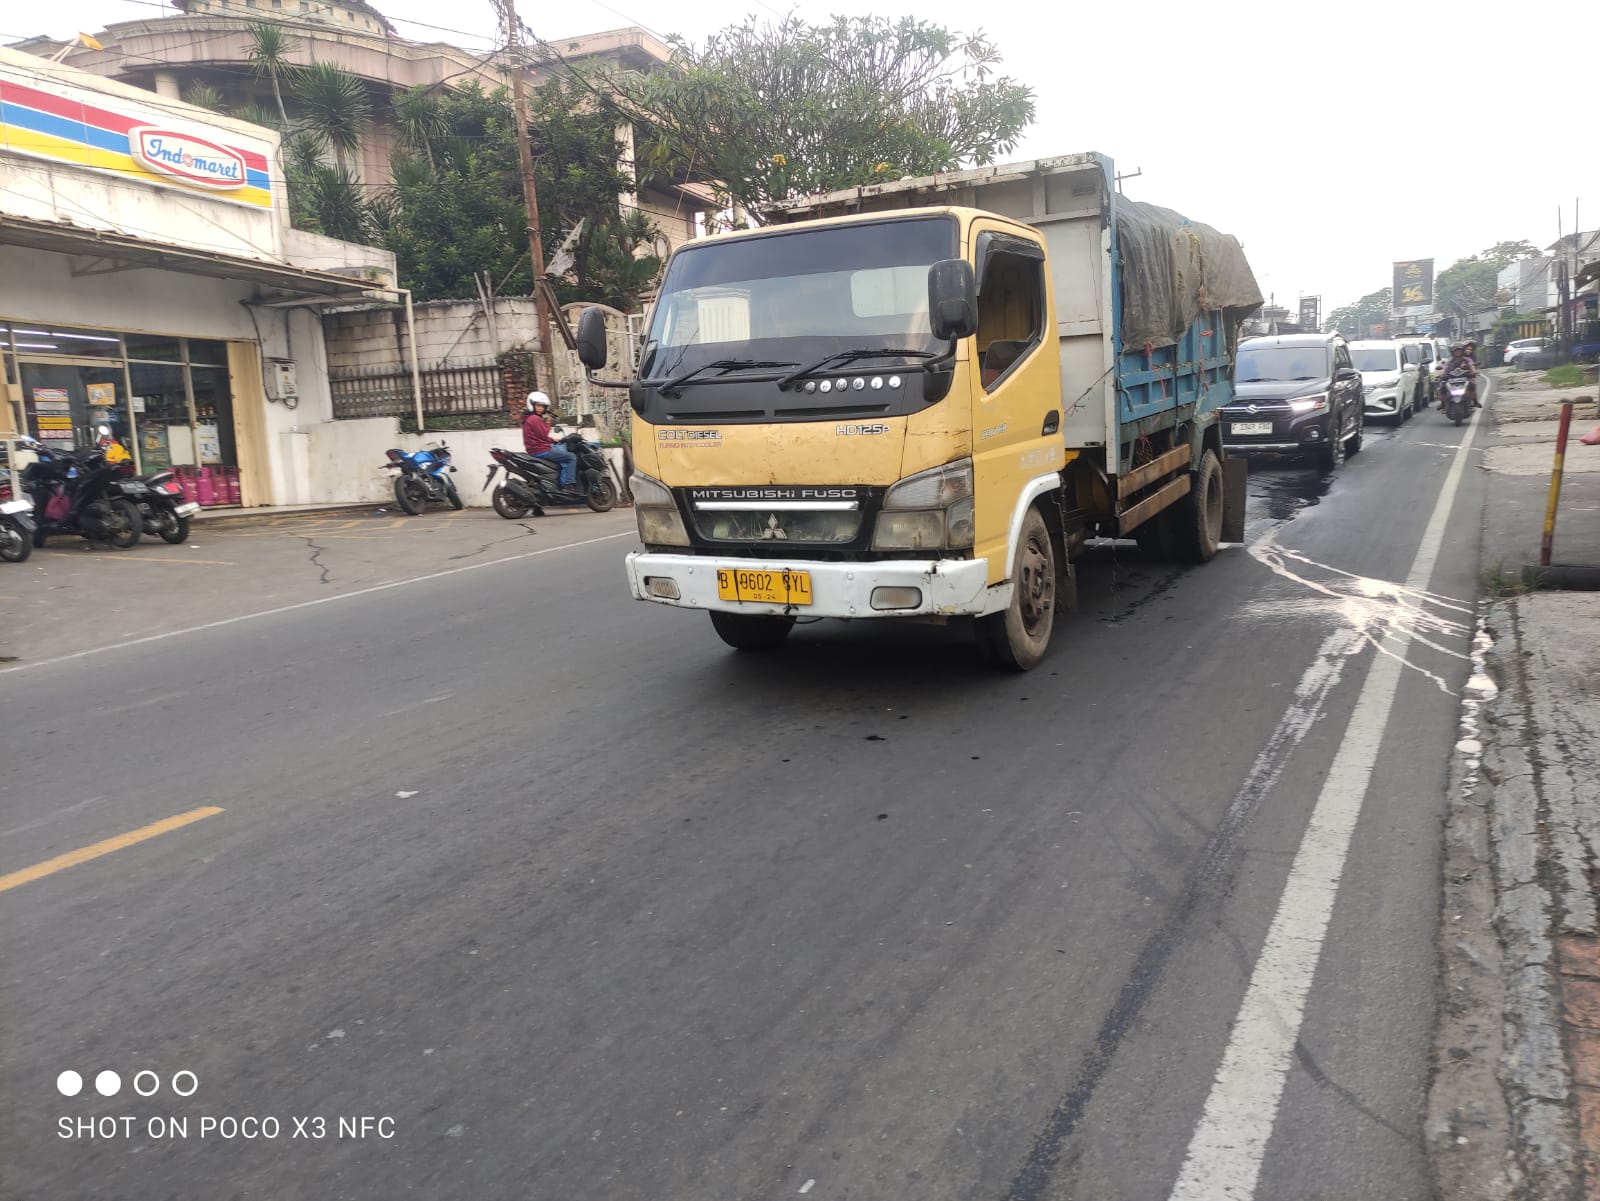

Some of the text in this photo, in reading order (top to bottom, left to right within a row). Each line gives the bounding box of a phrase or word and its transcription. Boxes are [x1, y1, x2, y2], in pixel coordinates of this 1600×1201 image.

[147, 138, 238, 179] Indomaret
[692, 490, 796, 498] MITSUBISHI
[720, 572, 729, 589] B
[740, 572, 773, 591] 9602
